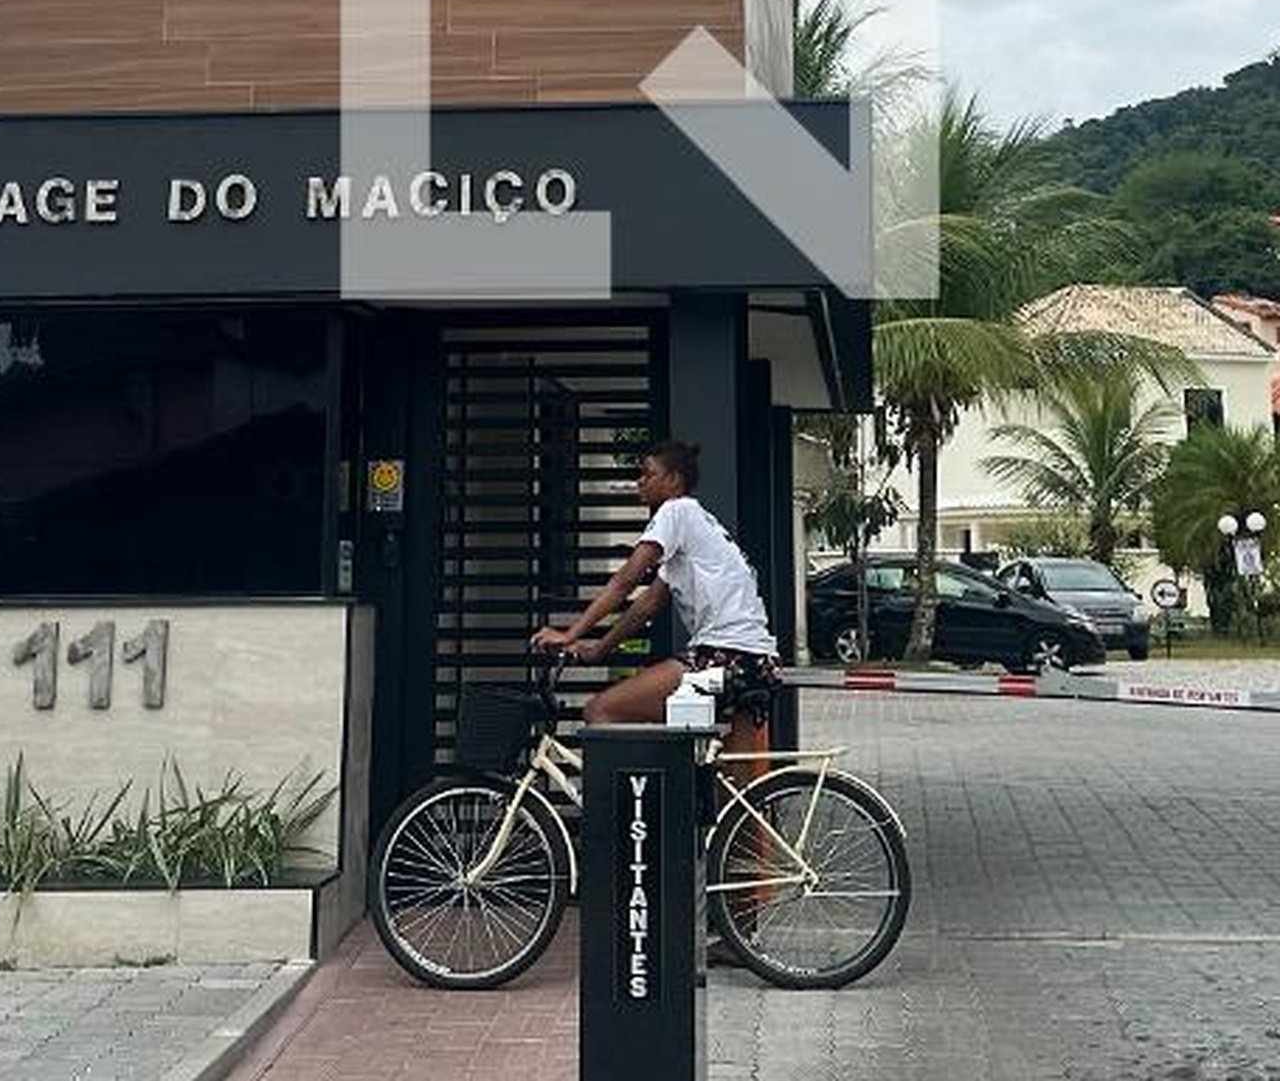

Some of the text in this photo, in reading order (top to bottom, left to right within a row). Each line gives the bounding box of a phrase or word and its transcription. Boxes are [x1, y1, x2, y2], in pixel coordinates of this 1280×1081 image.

[167, 173, 258, 221] DO
[306, 169, 576, 224] MACIÇO
[13, 620, 170, 710] 111
[629, 776, 648, 999] VISITANTES
